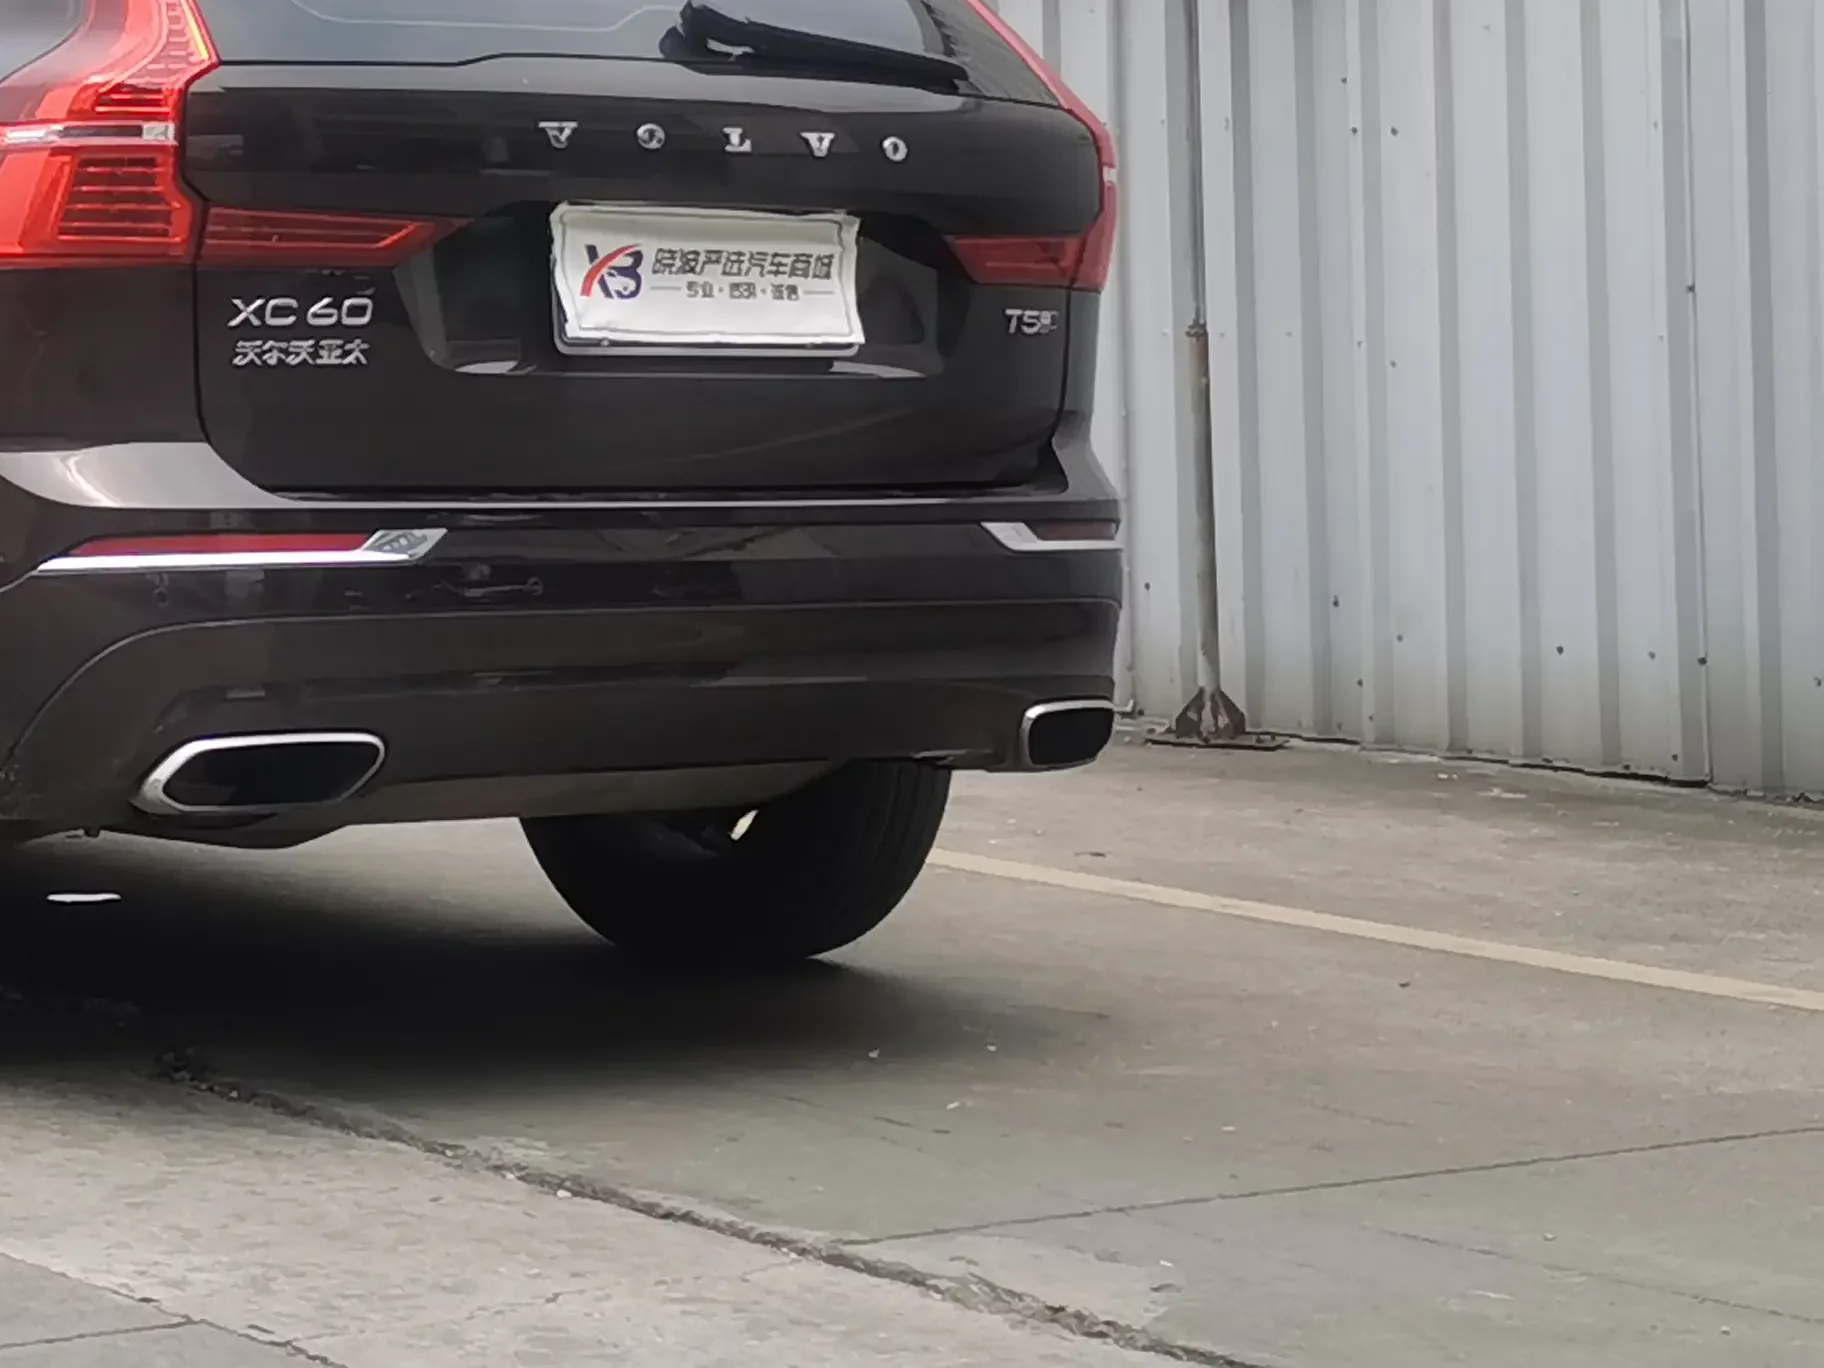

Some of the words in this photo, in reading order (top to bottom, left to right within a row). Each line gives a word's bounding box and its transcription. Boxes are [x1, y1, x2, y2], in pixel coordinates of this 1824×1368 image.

[538, 120, 908, 162] VOLVO
[232, 338, 370, 366] 沃尔沃亚太
